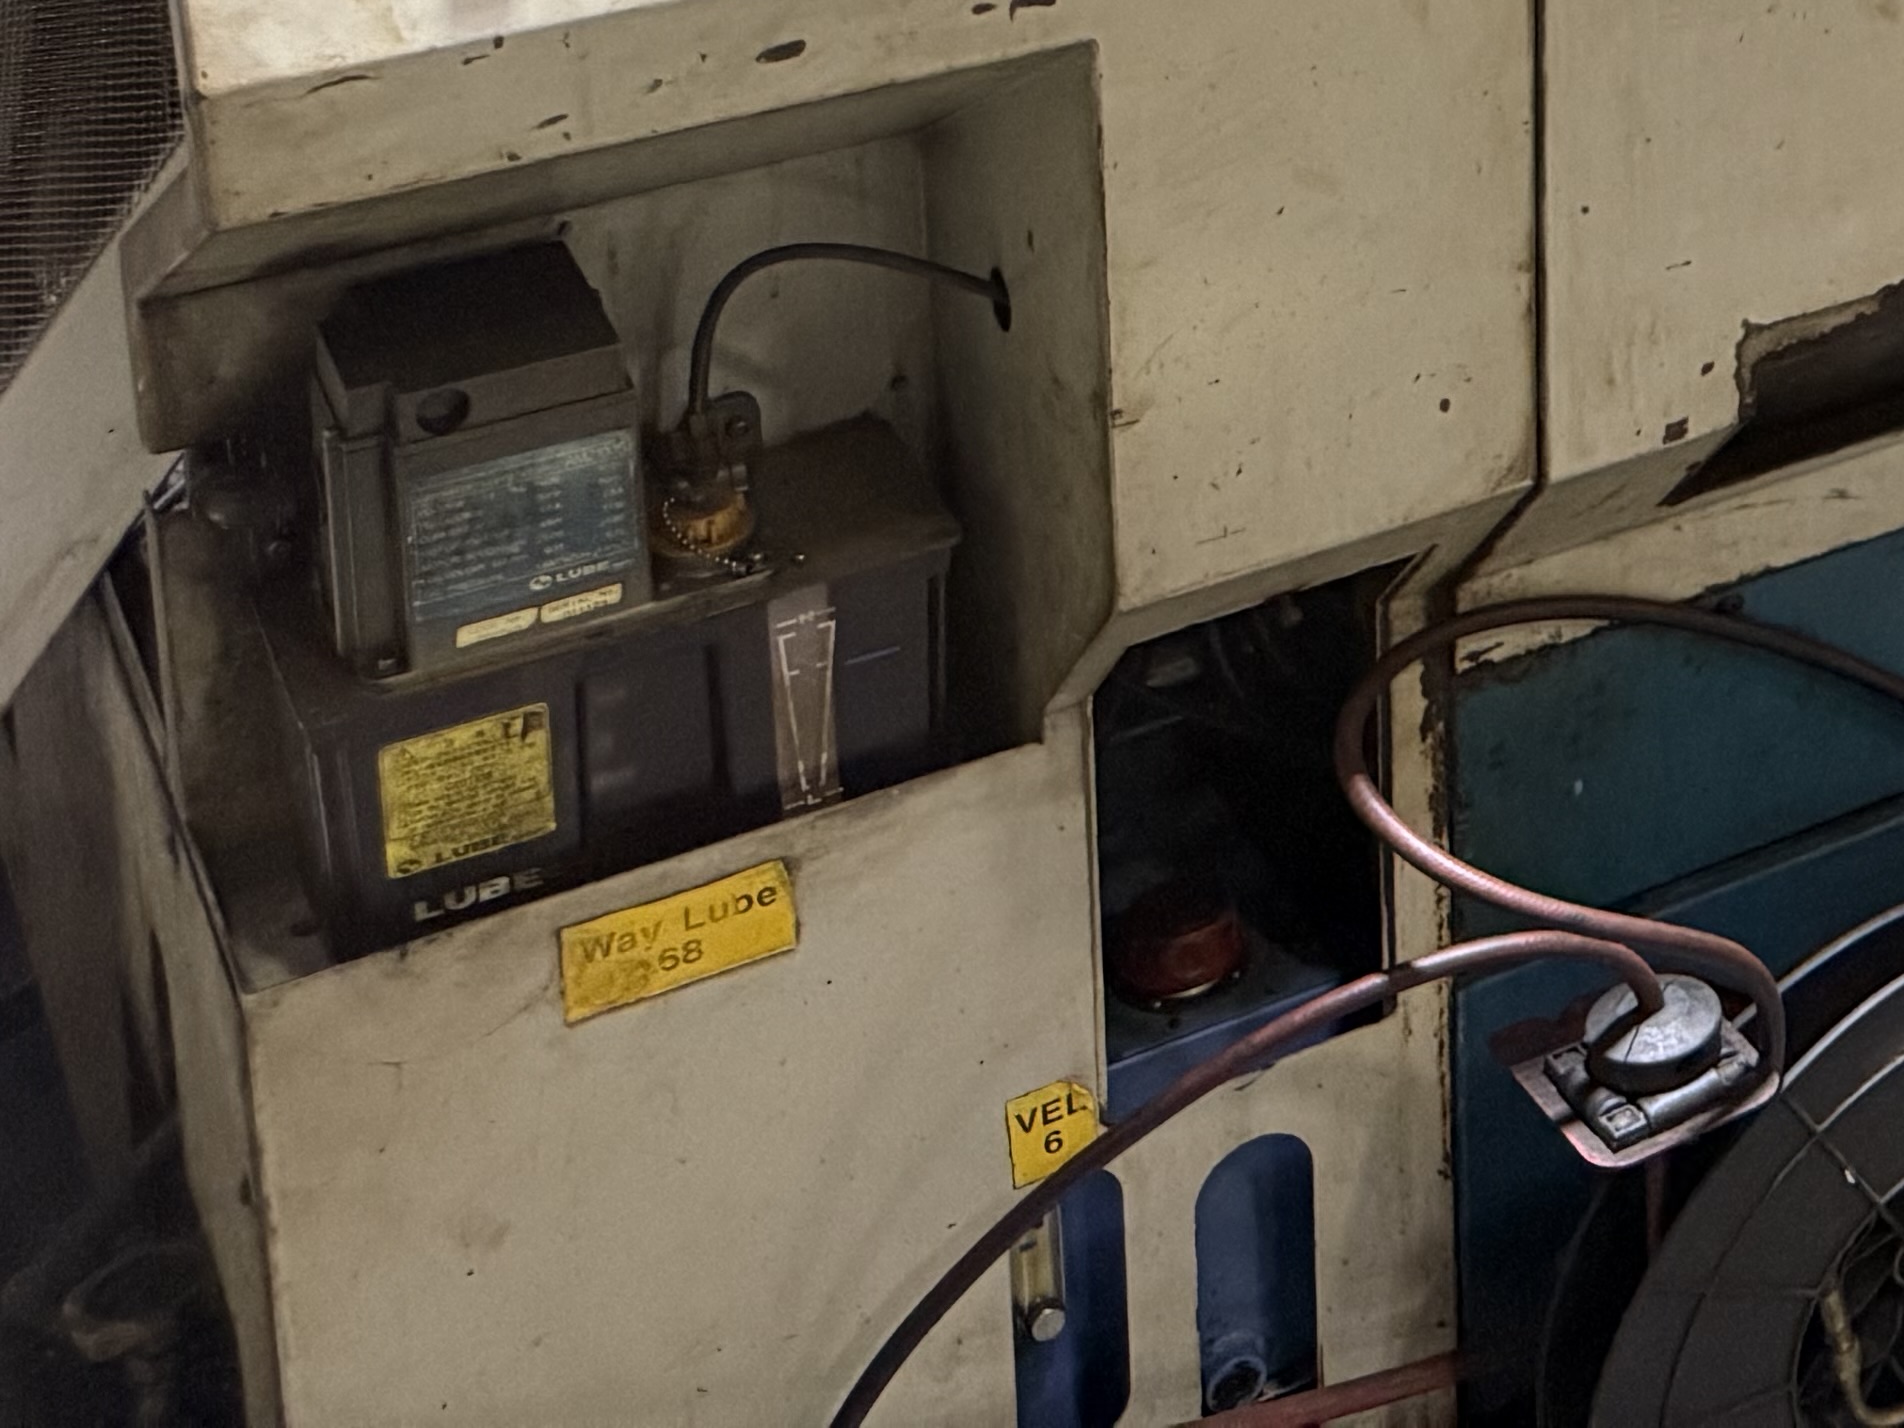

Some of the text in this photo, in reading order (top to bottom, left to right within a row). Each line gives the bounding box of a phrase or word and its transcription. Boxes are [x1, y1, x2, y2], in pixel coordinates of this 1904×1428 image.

[414, 867, 545, 922] LUBE
[580, 885, 777, 964] Way Lube
[1015, 1092, 1088, 1134] VEL
[1044, 1129, 1063, 1154] 6
